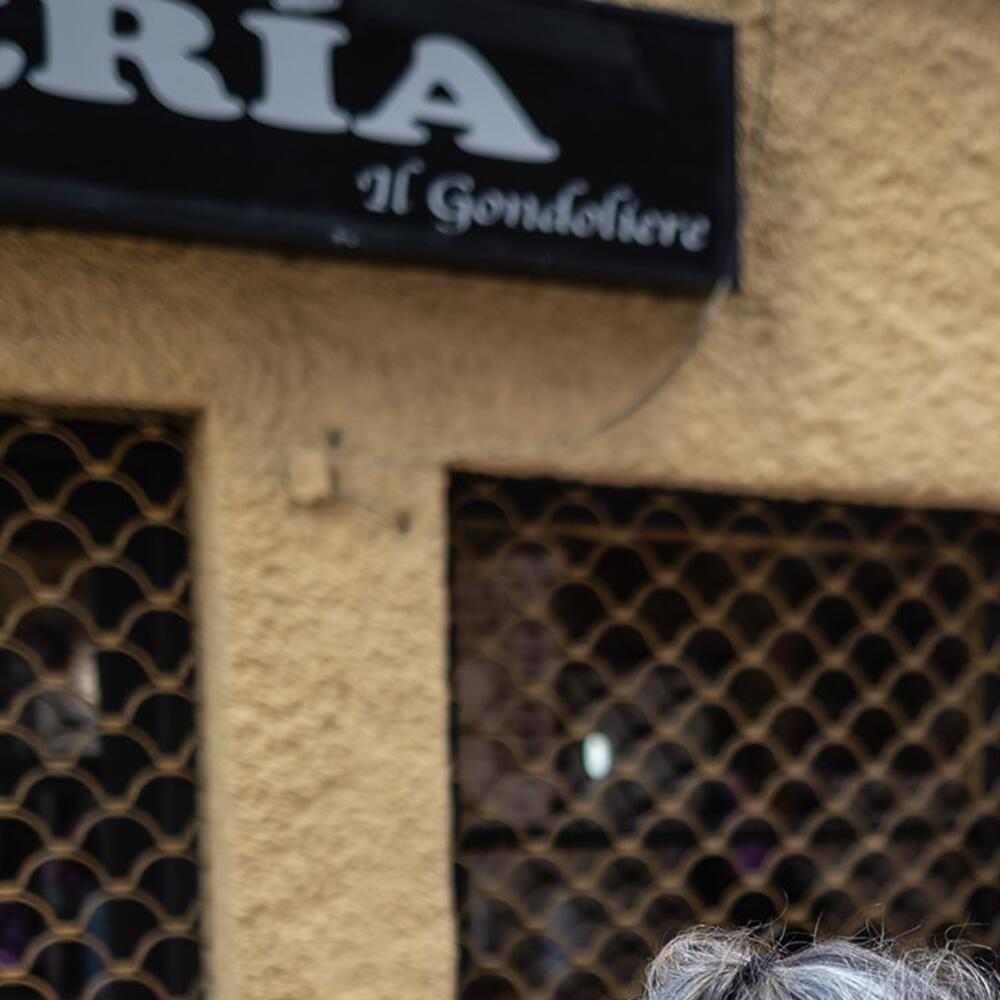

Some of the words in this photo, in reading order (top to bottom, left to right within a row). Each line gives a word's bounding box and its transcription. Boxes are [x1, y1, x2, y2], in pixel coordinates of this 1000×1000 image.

[0, 0, 560, 163] RÍA
[355, 156, 426, 215] Il
[426, 172, 711, 251] Gondoliere
